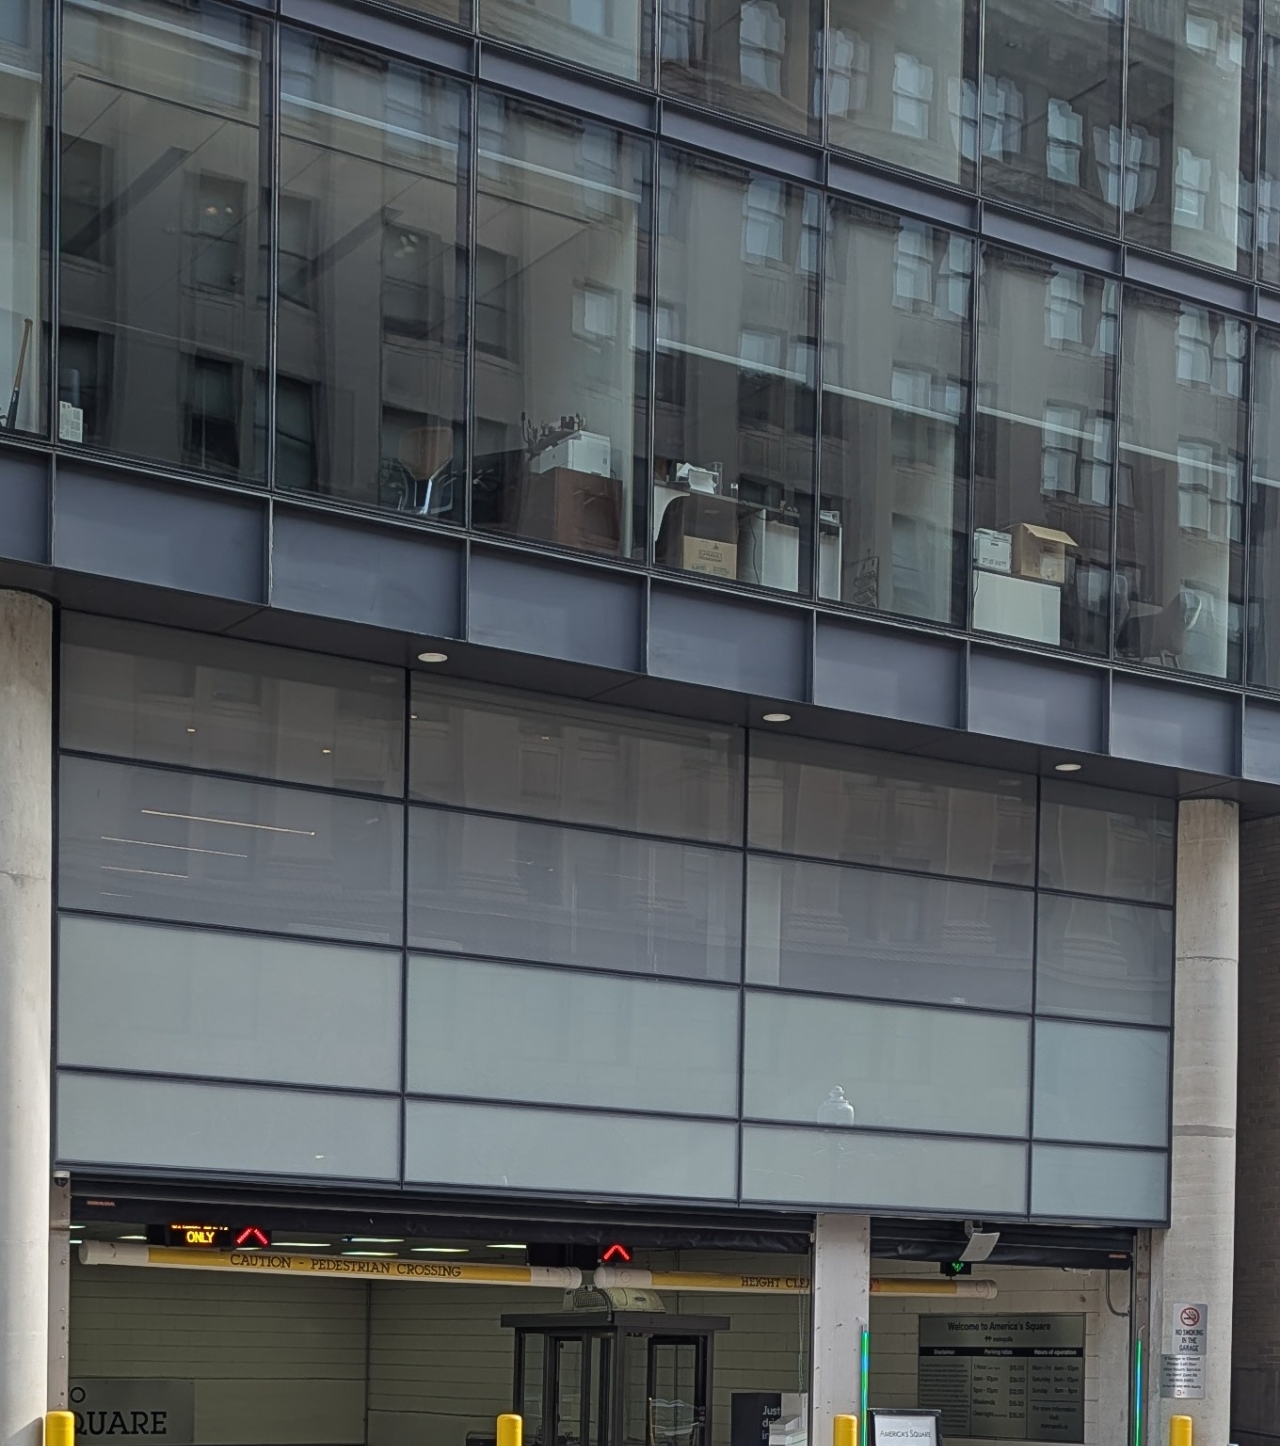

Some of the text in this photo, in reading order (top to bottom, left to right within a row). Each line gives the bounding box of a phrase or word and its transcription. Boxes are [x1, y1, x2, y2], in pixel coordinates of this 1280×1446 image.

[186, 1231, 215, 1243] ONLY
[230, 1254, 292, 1268] CAUTION
[310, 1258, 390, 1274] PEDESTRIAN
[396, 1263, 461, 1277] CROSSING
[741, 1277, 781, 1288] HEIGHT
[948, 1321, 1051, 1332] Welcome to America's Square
[762, 1406, 781, 1415] Just
[74, 1411, 167, 1435] QUARE
[880, 1430, 932, 1438] AMERICA'S SQUARE
